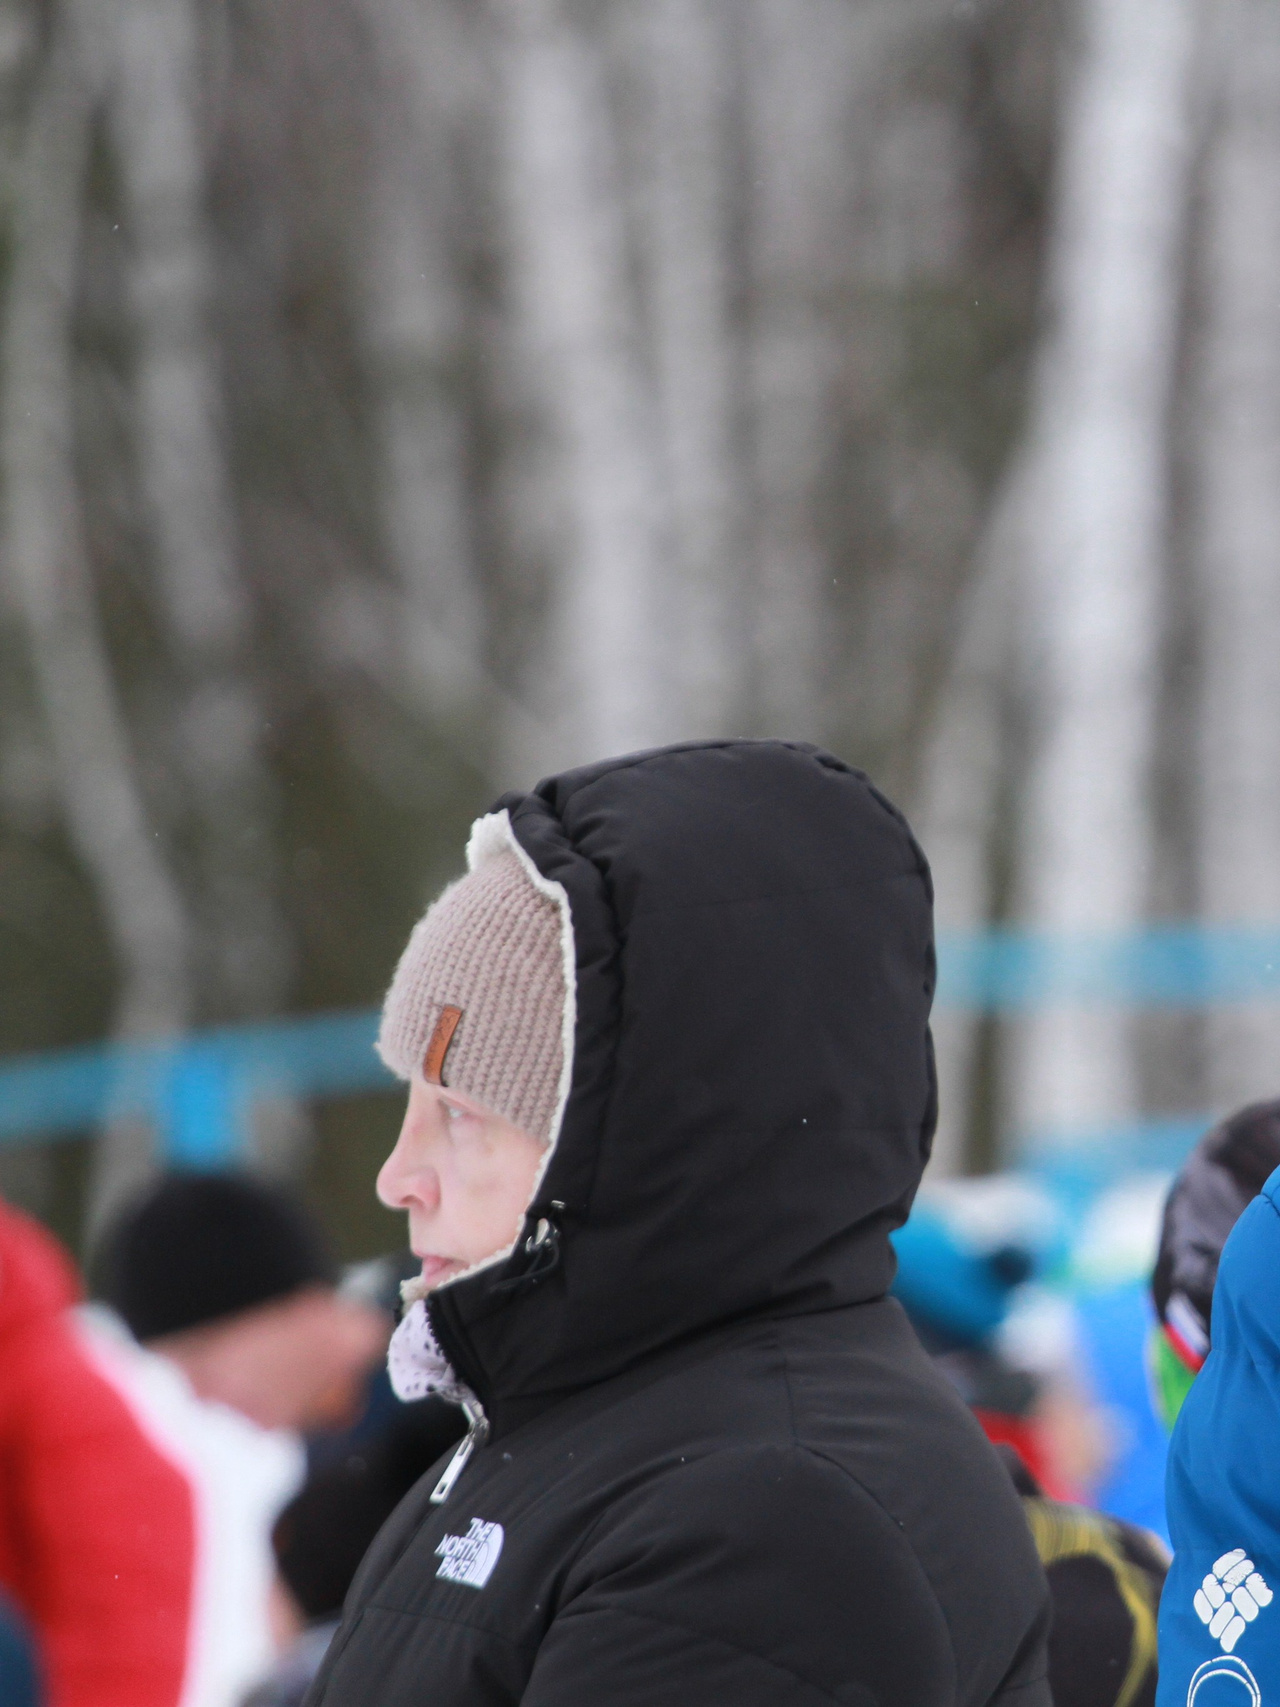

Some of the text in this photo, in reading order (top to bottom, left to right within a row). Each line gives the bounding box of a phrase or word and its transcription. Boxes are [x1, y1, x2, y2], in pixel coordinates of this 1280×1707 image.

[466, 1517, 496, 1541] THE
[434, 1533, 483, 1560] NORTH
[435, 1555, 471, 1580] FACE
